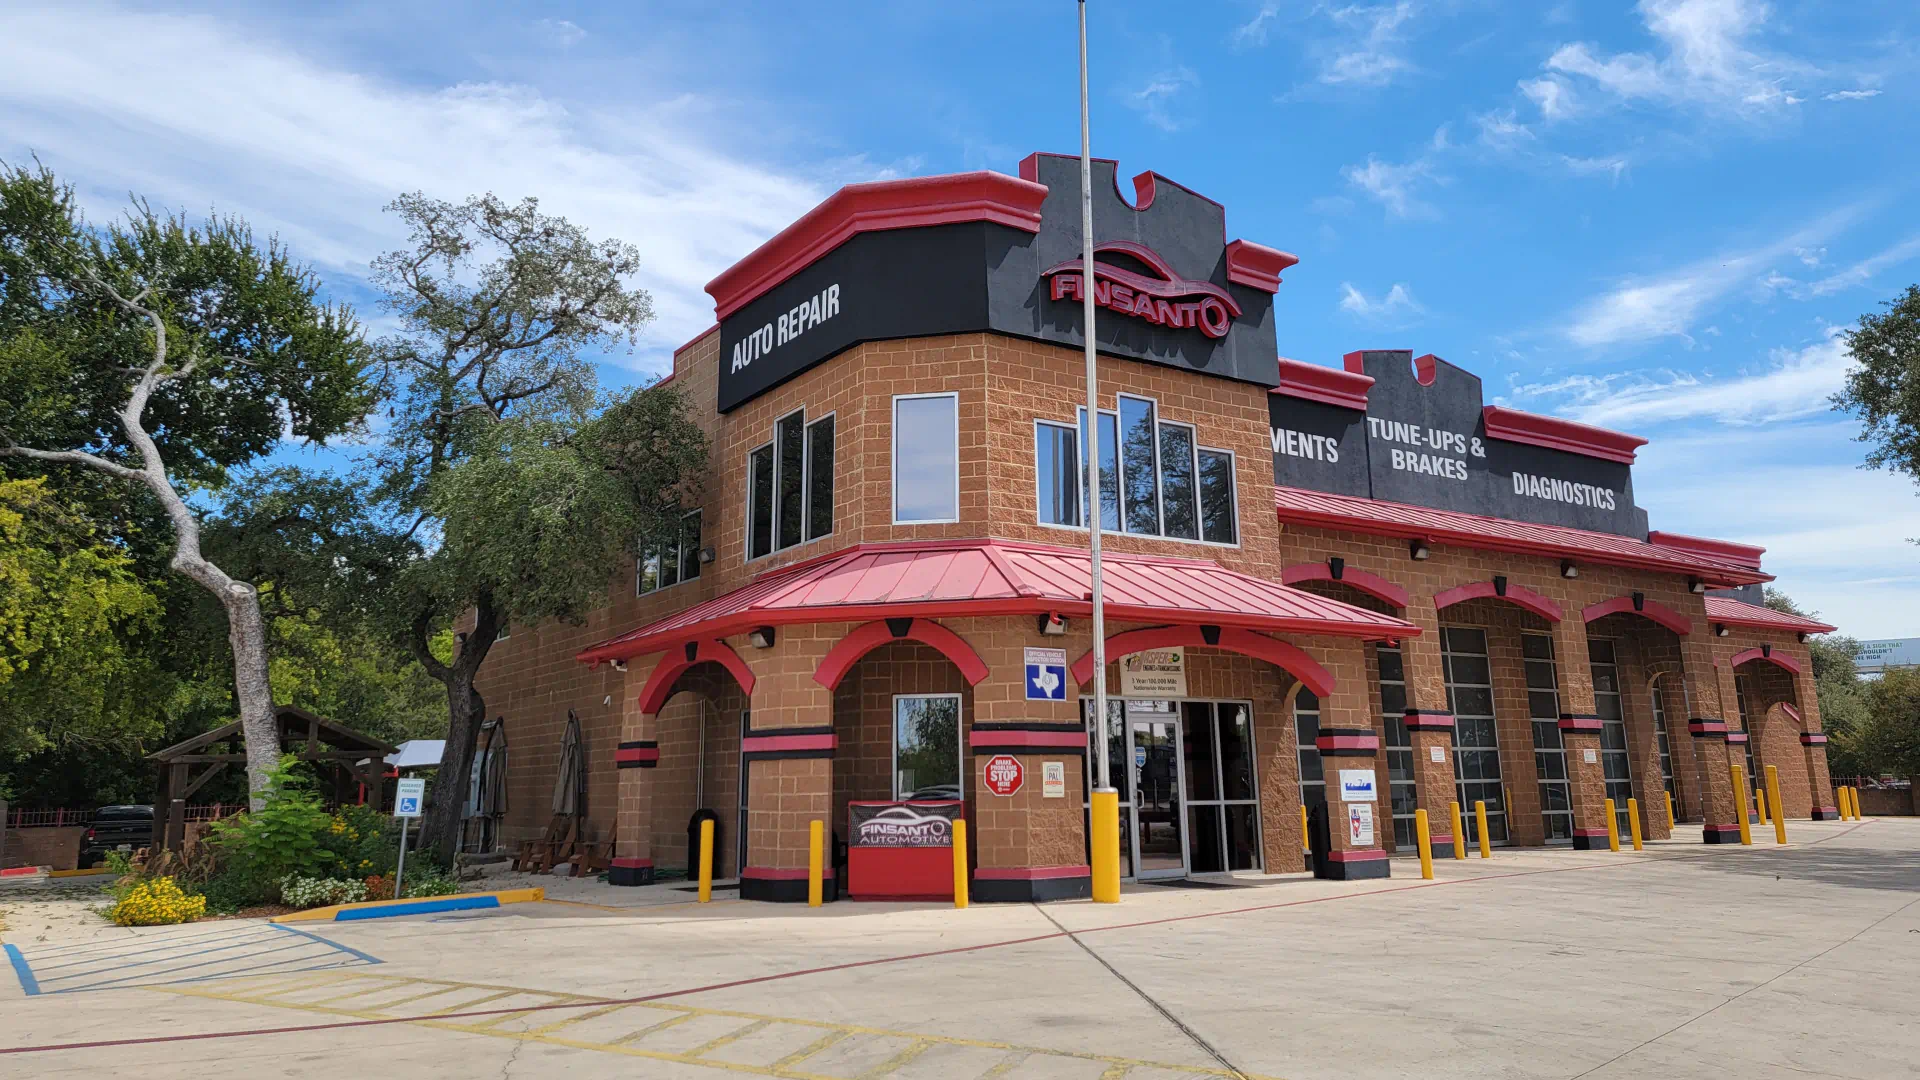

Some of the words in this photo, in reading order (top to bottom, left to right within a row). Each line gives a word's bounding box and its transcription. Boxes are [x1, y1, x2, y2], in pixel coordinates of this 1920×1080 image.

[1051, 275, 1230, 338] FINSANTO
[731, 323, 773, 375] AUTO
[777, 283, 840, 347] REPAIR
[1270, 427, 1339, 463] MENTS
[1367, 417, 1466, 454] TUNE-UPS
[1470, 436, 1486, 458] &
[1391, 449, 1468, 481] BRAKES
[1512, 471, 1616, 511] DIAGNOSTICS
[990, 771, 1018, 781] STOP
[860, 836, 949, 844] AUTOMOTIVE
[861, 822, 945, 836] FINSANTO
